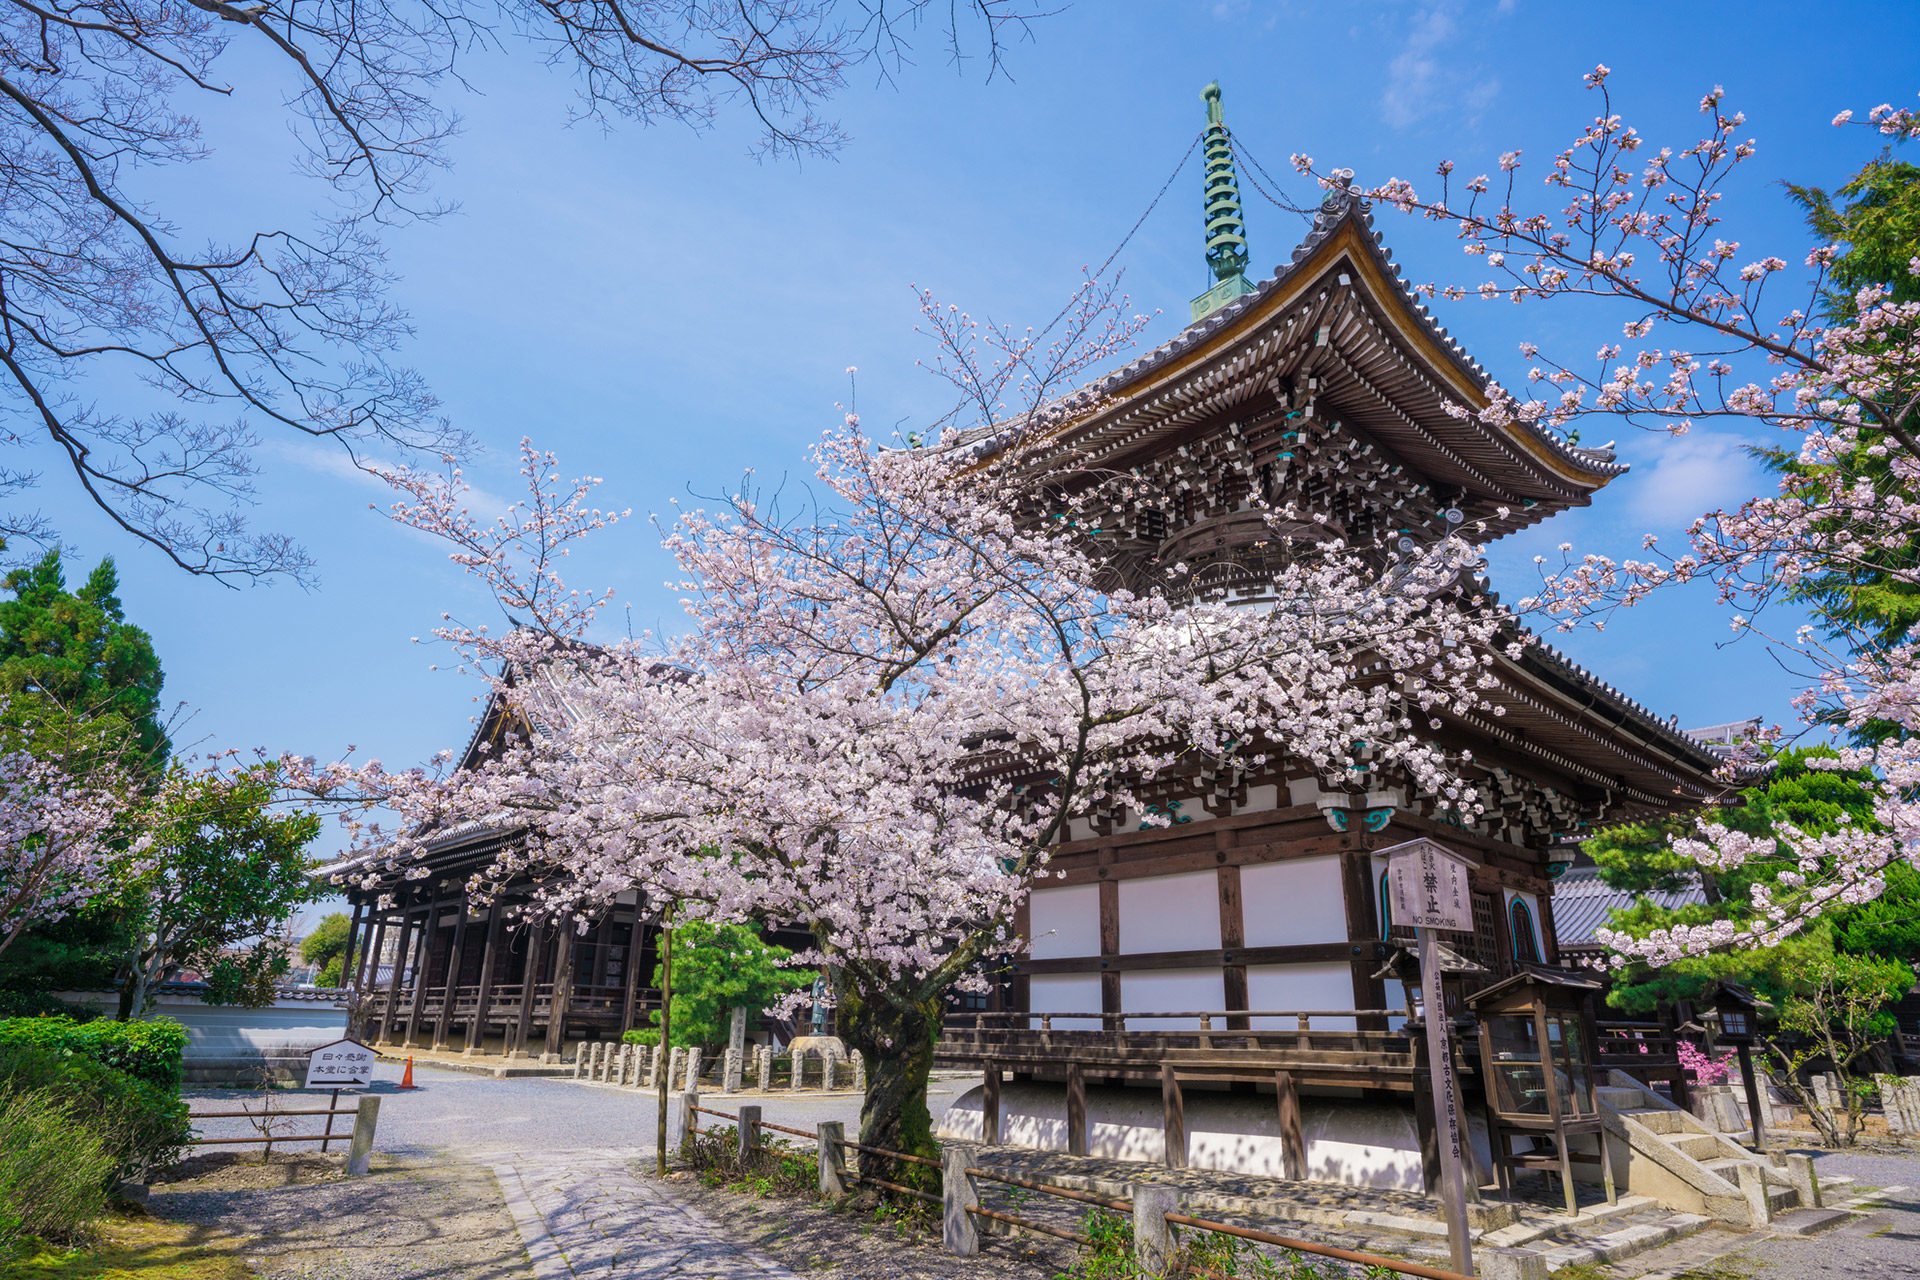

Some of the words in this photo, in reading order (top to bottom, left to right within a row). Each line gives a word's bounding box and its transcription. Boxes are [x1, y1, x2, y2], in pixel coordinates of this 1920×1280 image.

[1423, 872, 1441, 914] 禁止
[1450, 863, 1461, 910] 境内全域
[1412, 915, 1423, 925] NO
[1425, 917, 1457, 927] SMOKING
[313, 1065, 370, 1075] 本堂に合掌
[322, 1052, 367, 1062] 日々感謝
[1440, 1037, 1460, 1159] 京都古文化保存協会
